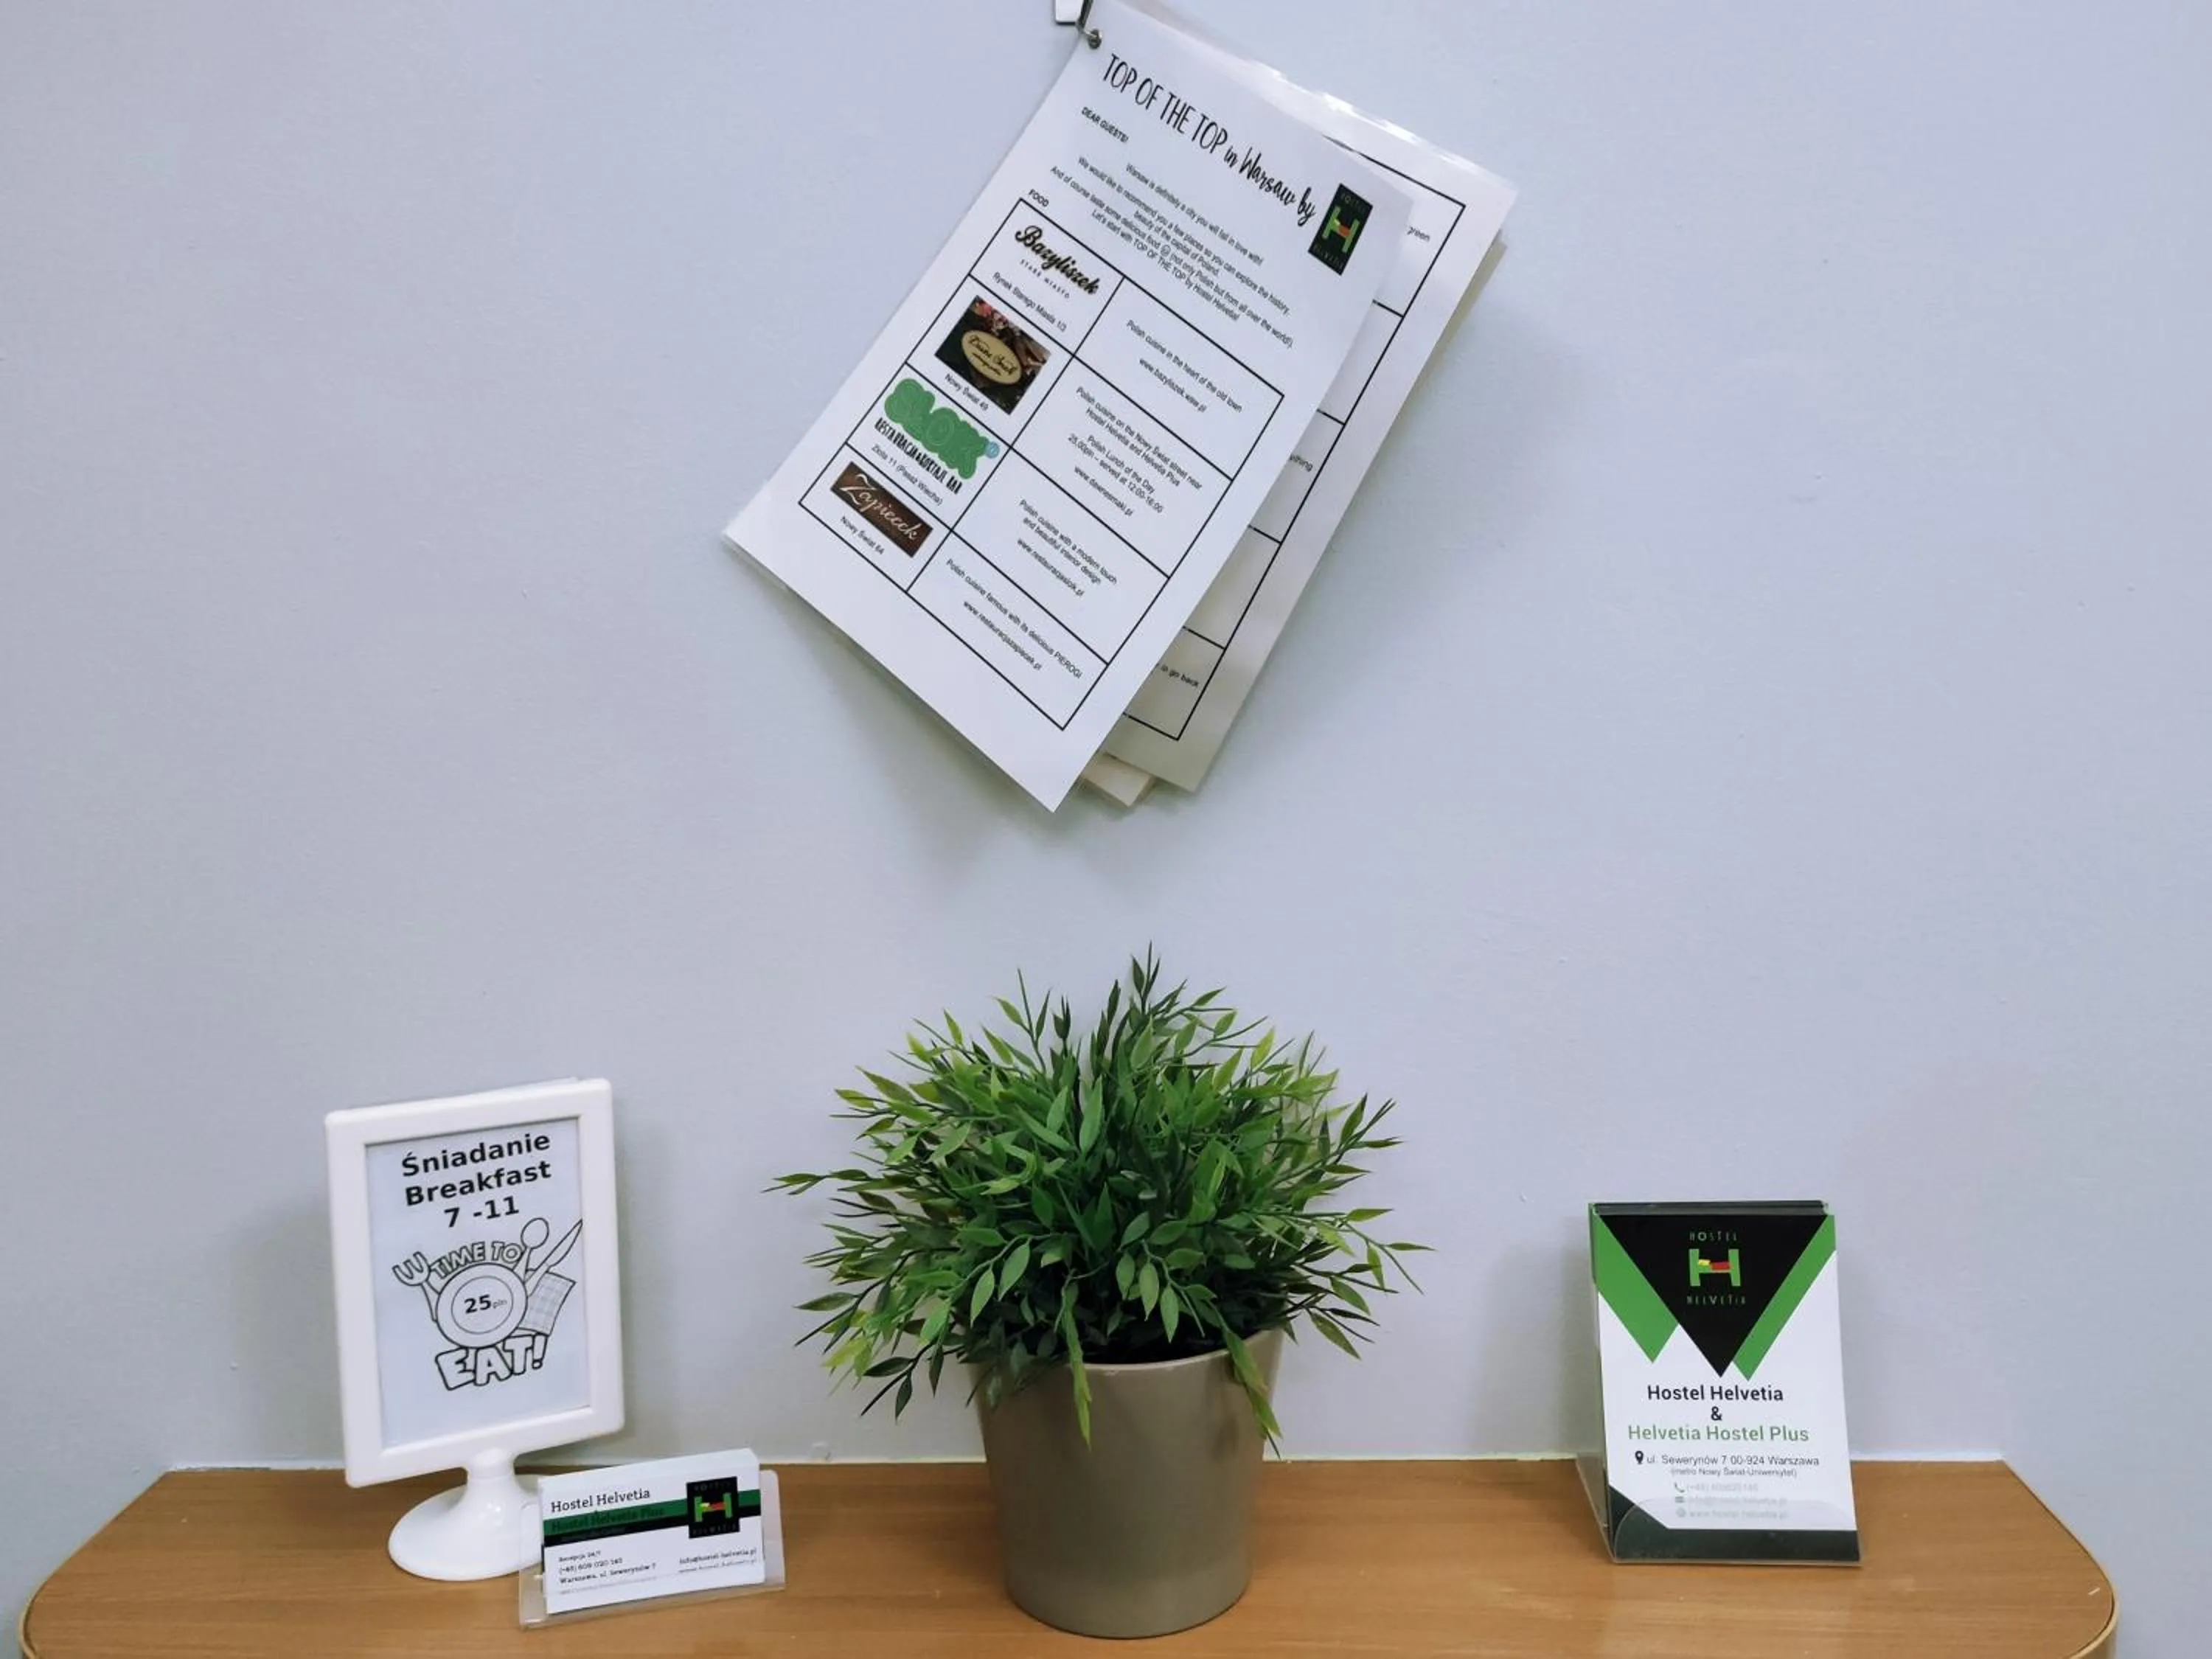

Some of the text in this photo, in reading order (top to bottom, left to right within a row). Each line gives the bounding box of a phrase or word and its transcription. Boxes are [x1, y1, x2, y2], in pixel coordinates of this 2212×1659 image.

[1080, 105, 1101, 125] DEAR
[1102, 52, 1137, 93] TOP
[1135, 77, 1164, 110] OF
[1159, 91, 1196, 133] THE
[1191, 113, 1228, 153] TOP
[1223, 145, 1237, 168] in
[1238, 147, 1295, 206] Warsaw
[1297, 187, 1315, 227] by
[1027, 188, 1049, 207] FOOD
[1014, 225, 1100, 294] Bazyliszek
[1141, 479, 1155, 494] Day
[839, 473, 919, 542] Zapiecek
[402, 1133, 550, 1177] Śniadanie
[406, 1160, 552, 1206] Breakfast
[444, 1207, 460, 1228] 7
[430, 1241, 523, 1279] TIME TO
[434, 1332, 549, 1391] EAT!
[1647, 1385, 1784, 1401] Hostel Helvetia
[1711, 1406, 1722, 1421] &
[1628, 1425, 1809, 1441] Helvetia Hostel Plus
[1661, 1455, 1820, 1467] Sewerynów 7 00-924 Warszawa
[552, 1488, 650, 1513] Hostel Helvetia
